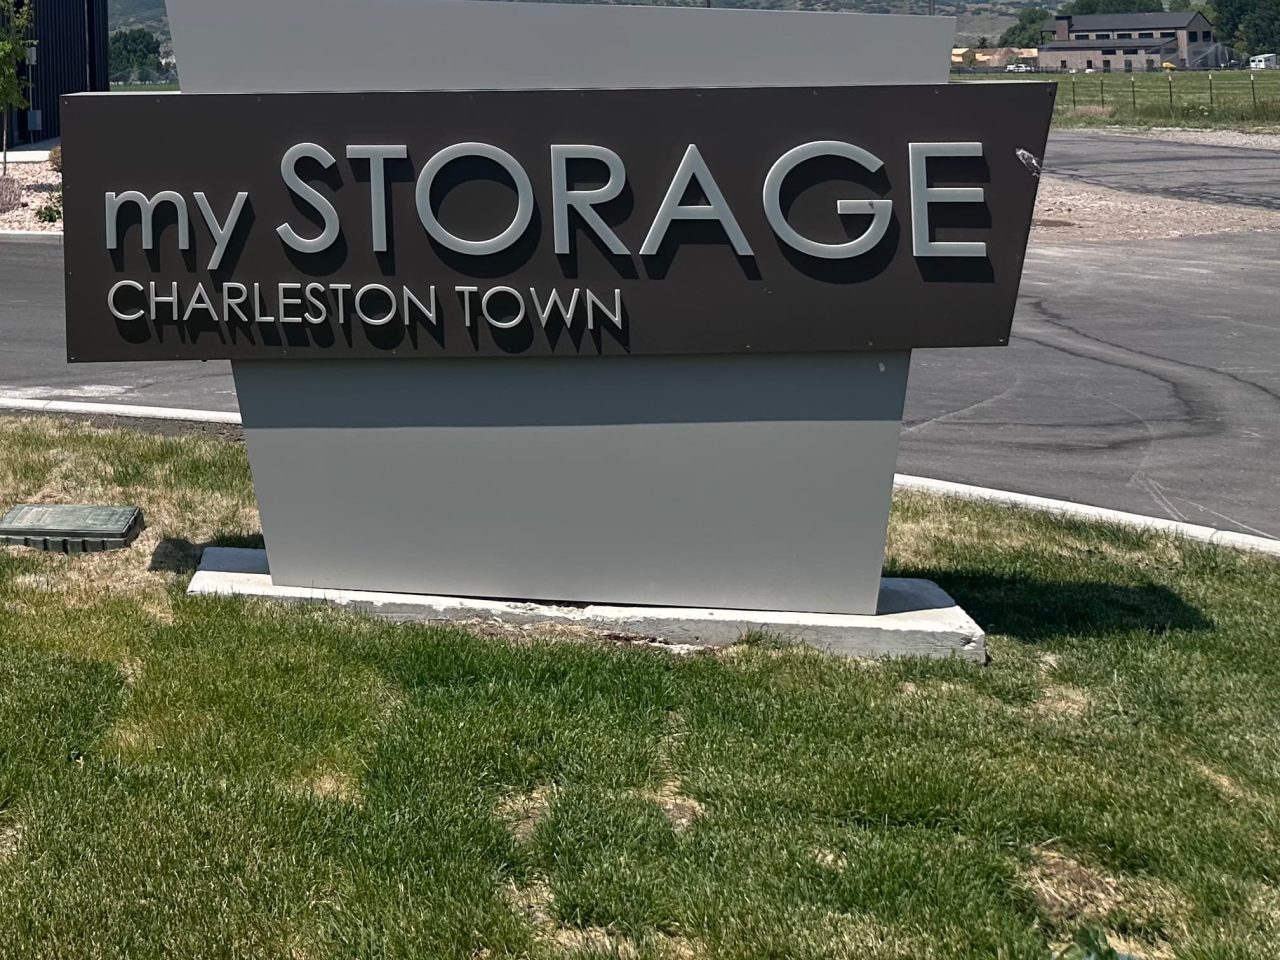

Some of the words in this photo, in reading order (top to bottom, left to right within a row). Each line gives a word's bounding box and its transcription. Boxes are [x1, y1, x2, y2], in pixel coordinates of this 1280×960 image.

[104, 190, 249, 270] my
[275, 140, 987, 259] STORAGE
[107, 279, 437, 326] CHARLESTON
[454, 285, 622, 330] TOWN
